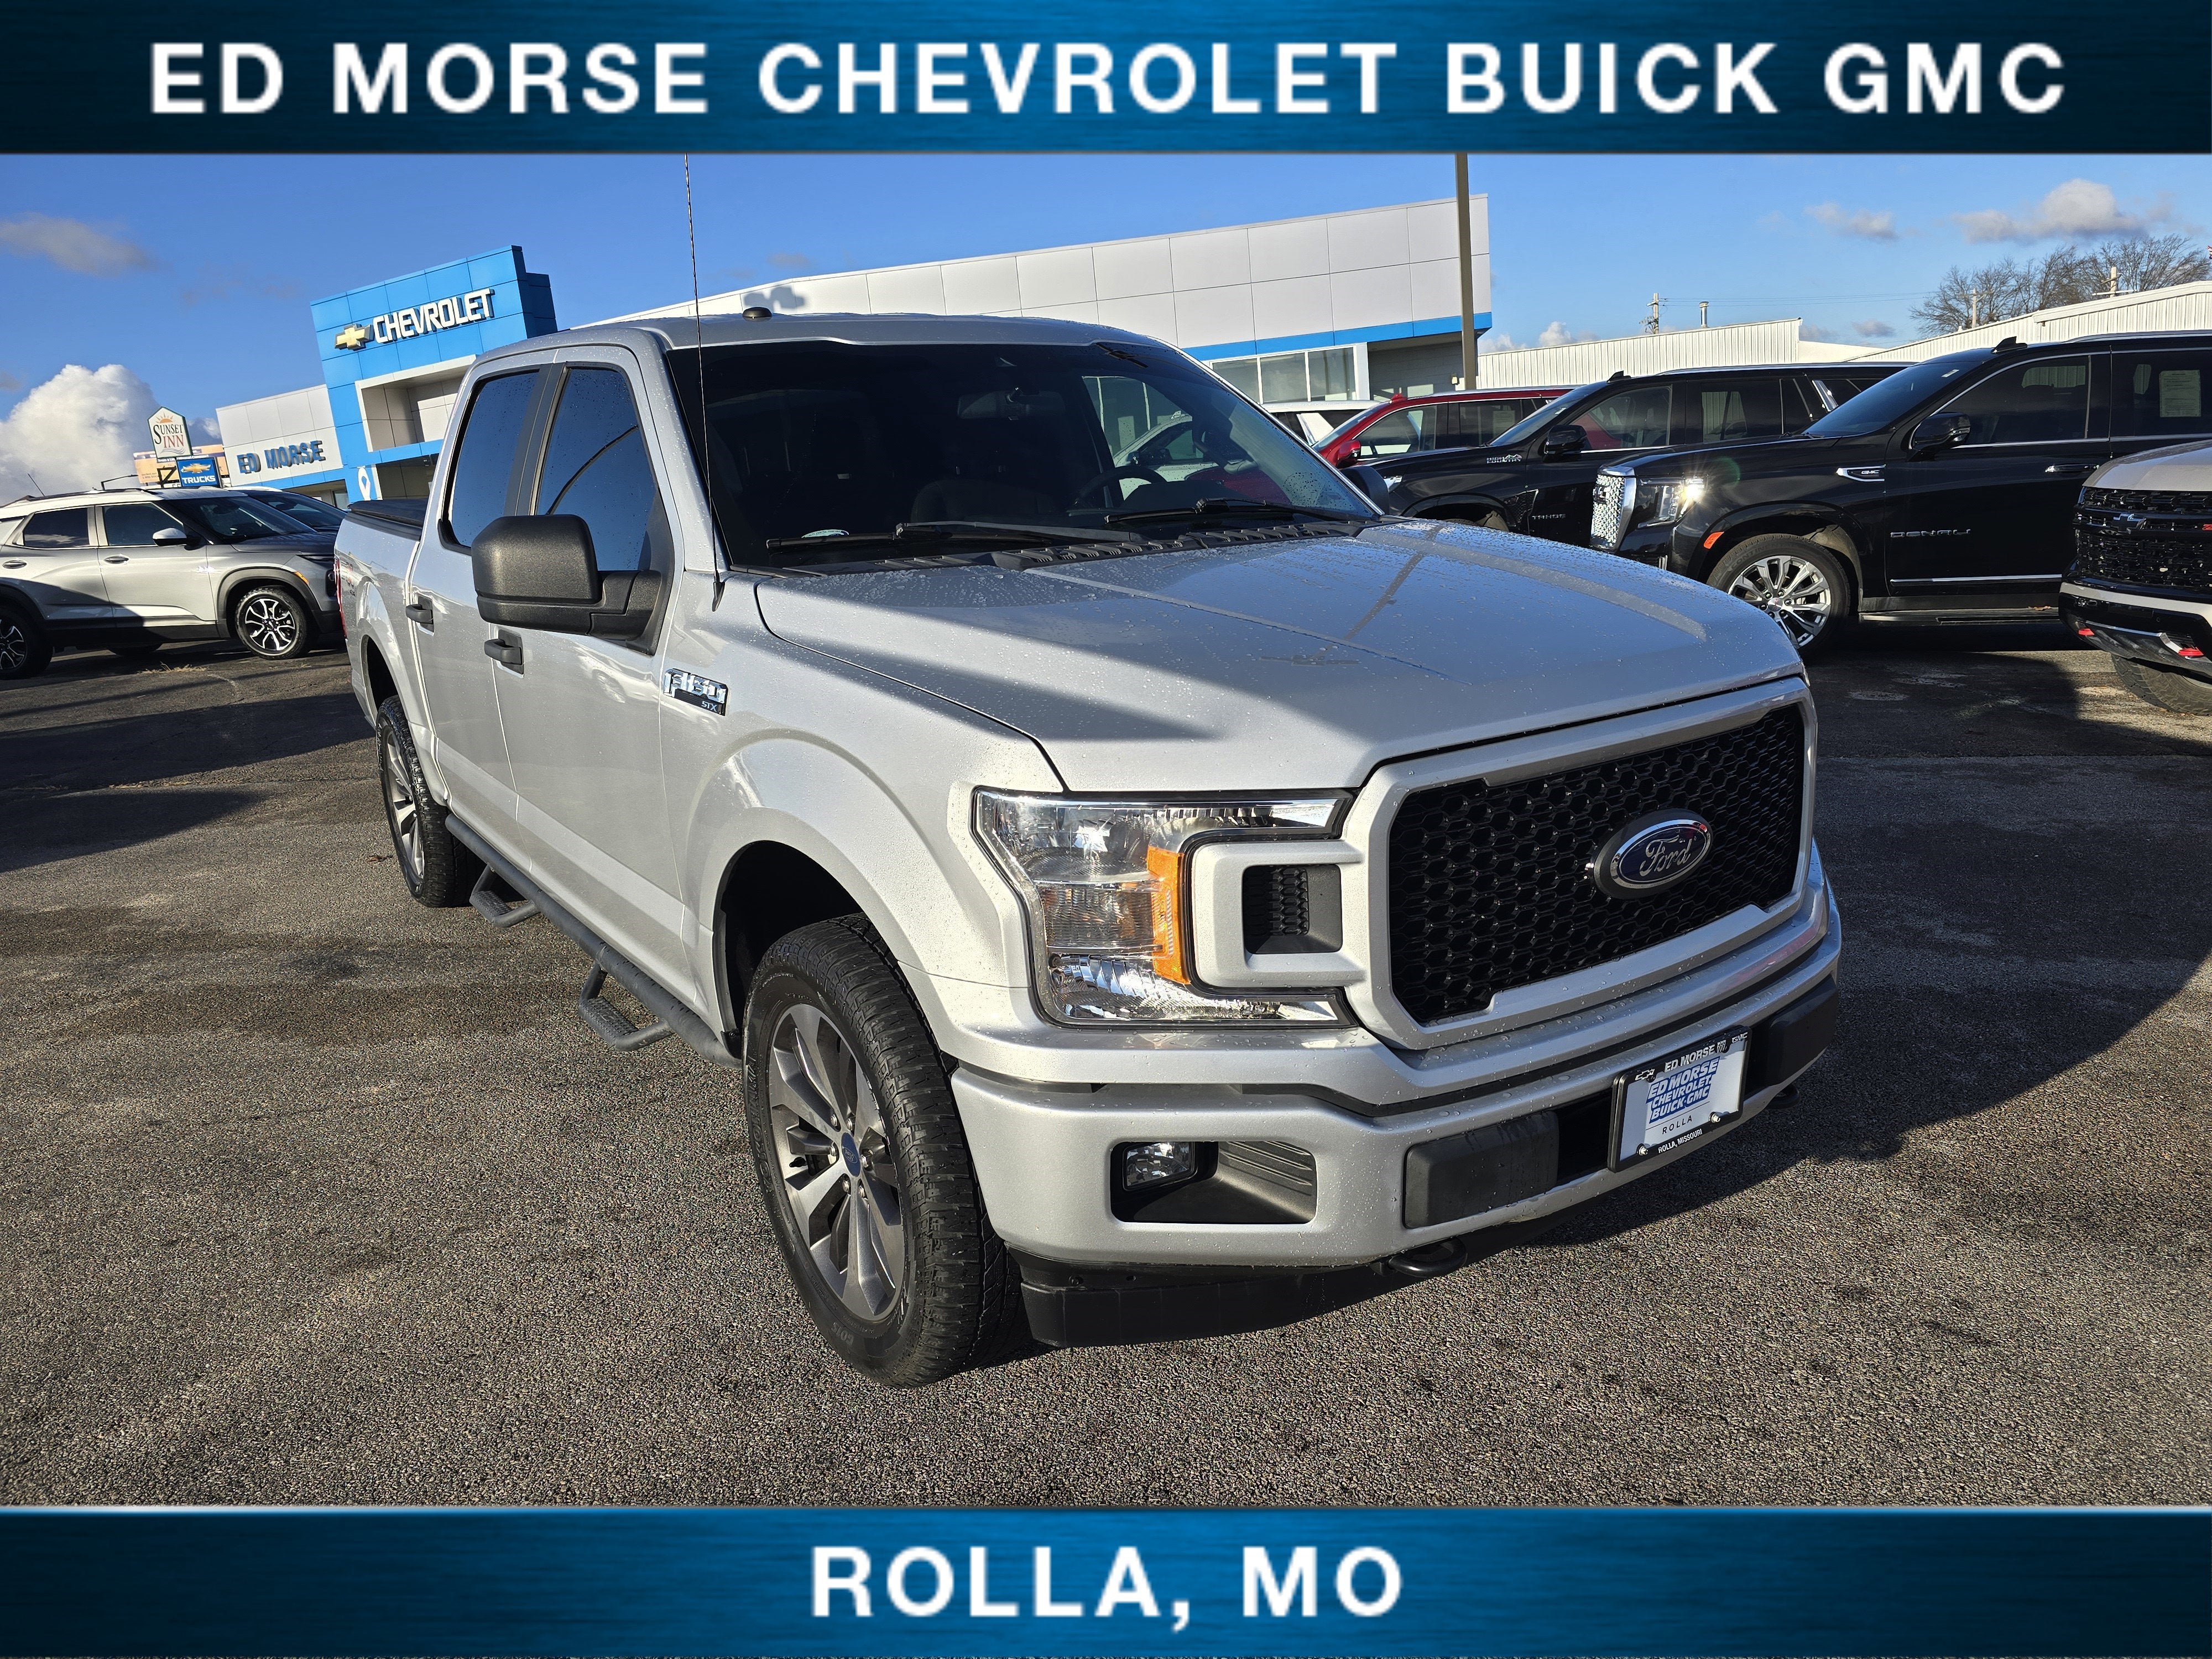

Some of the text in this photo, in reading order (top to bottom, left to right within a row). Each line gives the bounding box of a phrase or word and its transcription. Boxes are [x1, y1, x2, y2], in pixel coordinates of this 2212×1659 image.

[373, 288, 495, 343] CHEVROLET
[153, 424, 183, 445] SUNSET
[164, 435, 185, 448] INN
[237, 440, 326, 474] ED MORSE
[182, 475, 216, 484] TRUCKS
[1890, 529, 1971, 538] DENALI
[701, 701, 718, 712] STX
[1639, 834, 1693, 877] Ford
[1665, 1032, 1748, 1073] ED MORSE GMC
[1648, 1057, 1719, 1099] ED MORSE
[1652, 1074, 1712, 1109] CHEVROLET
[1662, 1115, 1692, 1135] ROLLA
[1658, 1128, 1703, 1154] ROLLA, MISSOURI
